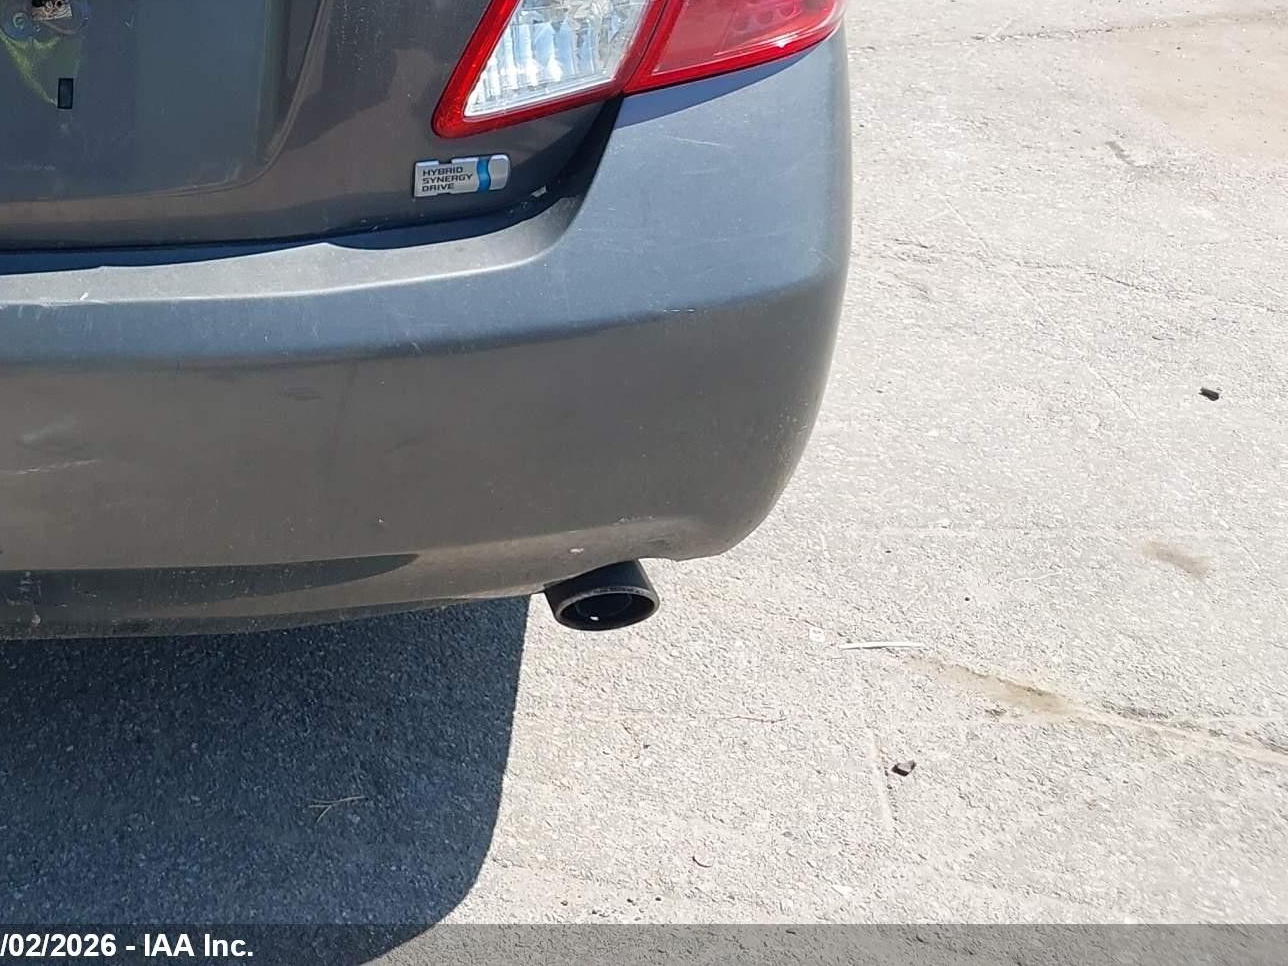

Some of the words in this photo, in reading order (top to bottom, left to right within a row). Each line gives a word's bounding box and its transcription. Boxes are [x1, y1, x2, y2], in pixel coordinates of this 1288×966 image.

[422, 166, 464, 177] HYBRID
[422, 174, 473, 184] SYNERGY
[421, 183, 455, 192] DRIVE
